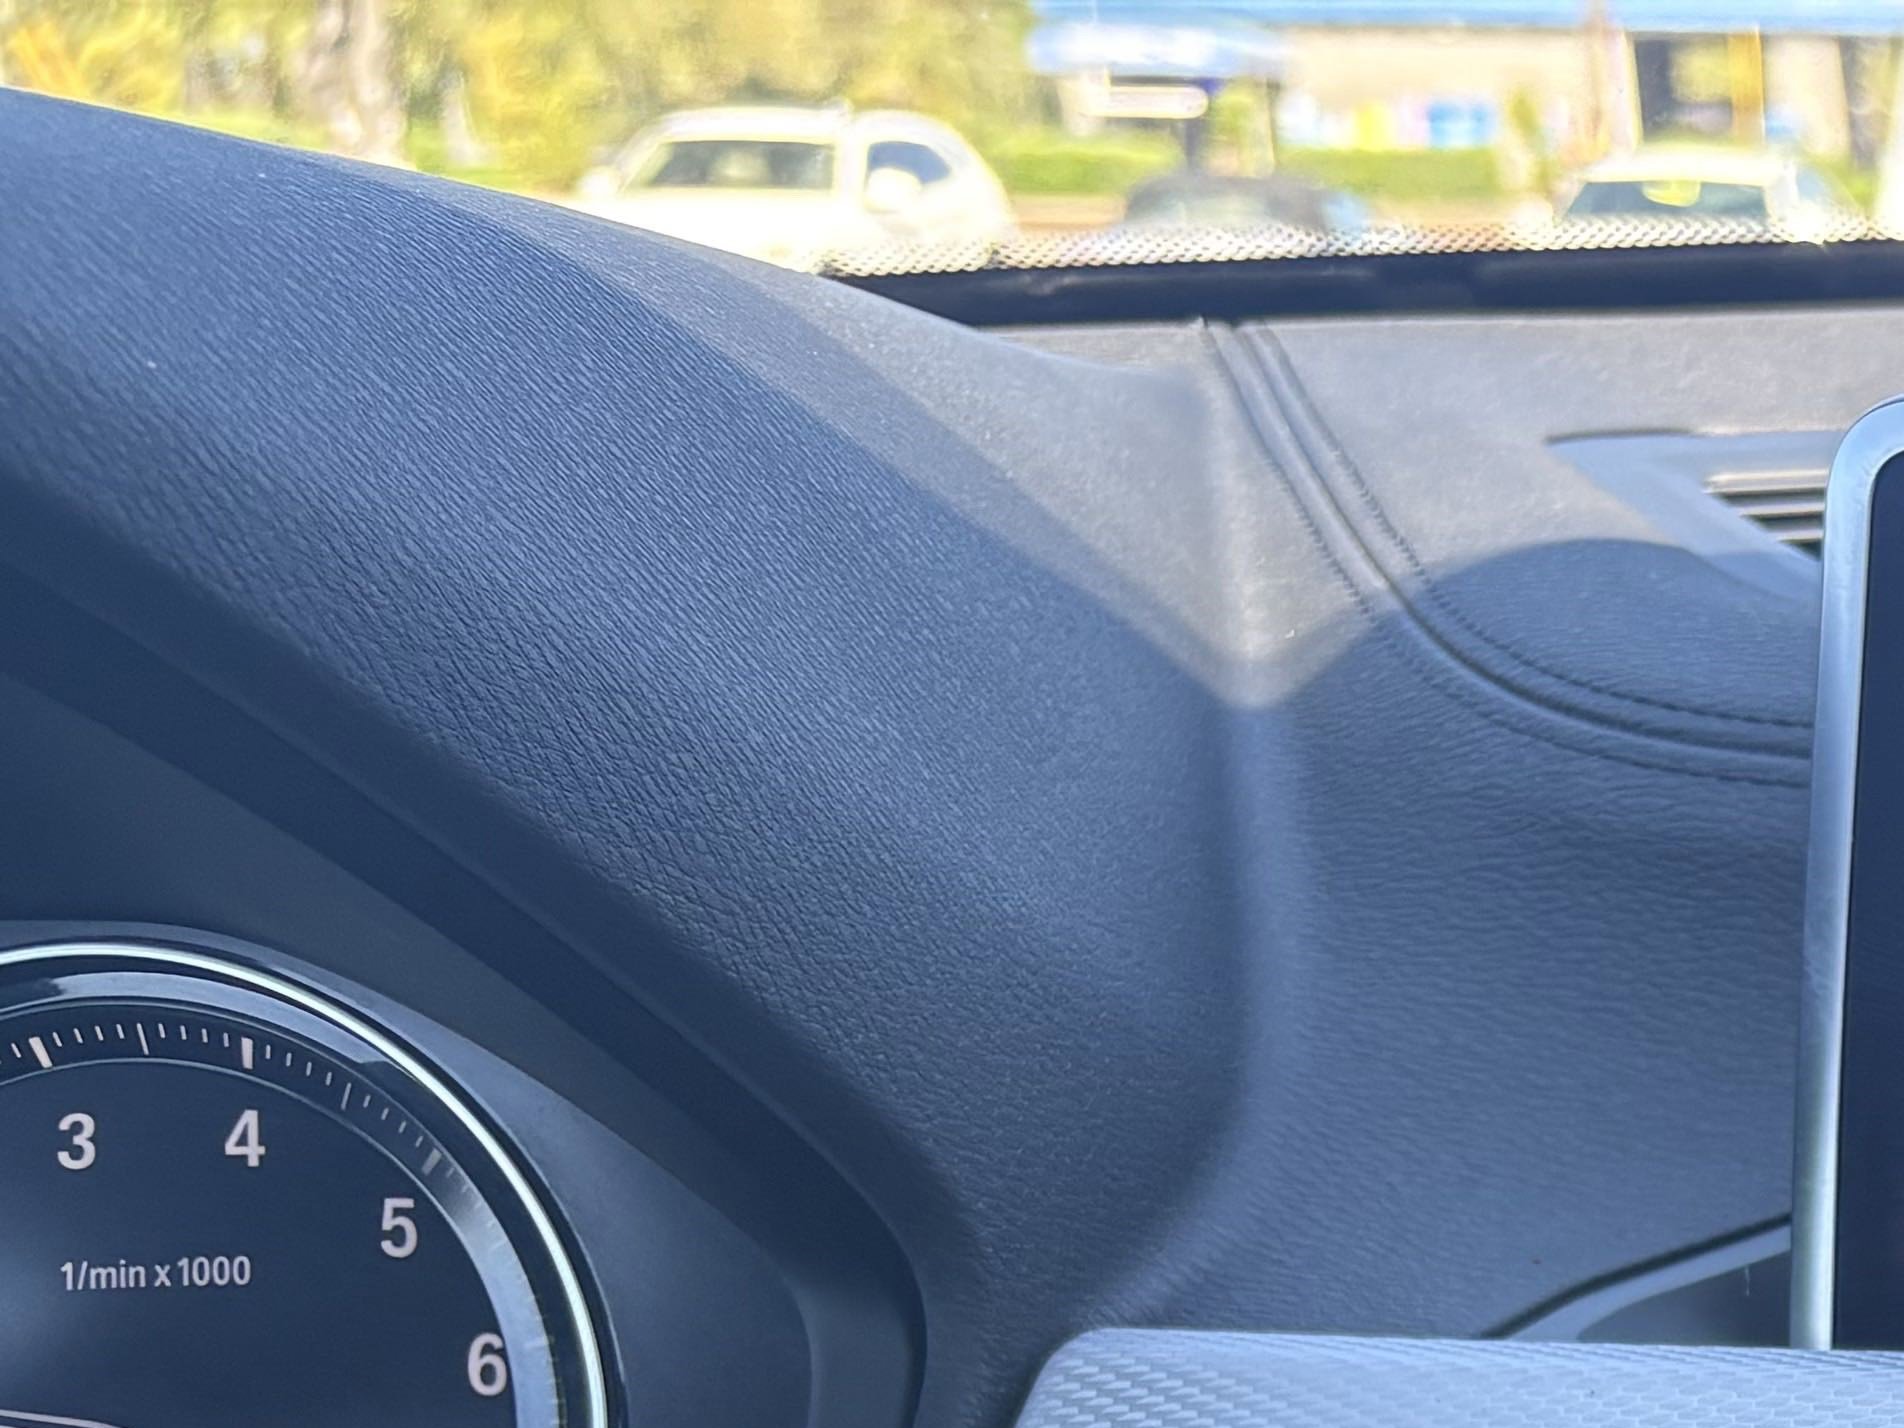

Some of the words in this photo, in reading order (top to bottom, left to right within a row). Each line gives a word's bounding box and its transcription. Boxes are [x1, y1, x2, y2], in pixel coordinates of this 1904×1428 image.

[57, 1112, 96, 1170] 3
[224, 1109, 266, 1167] 4
[380, 1197, 418, 1258] 5
[60, 1259, 146, 1291] 1/min
[154, 1264, 172, 1287] x
[177, 1255, 251, 1287] 1000
[467, 1332, 507, 1396] 6
